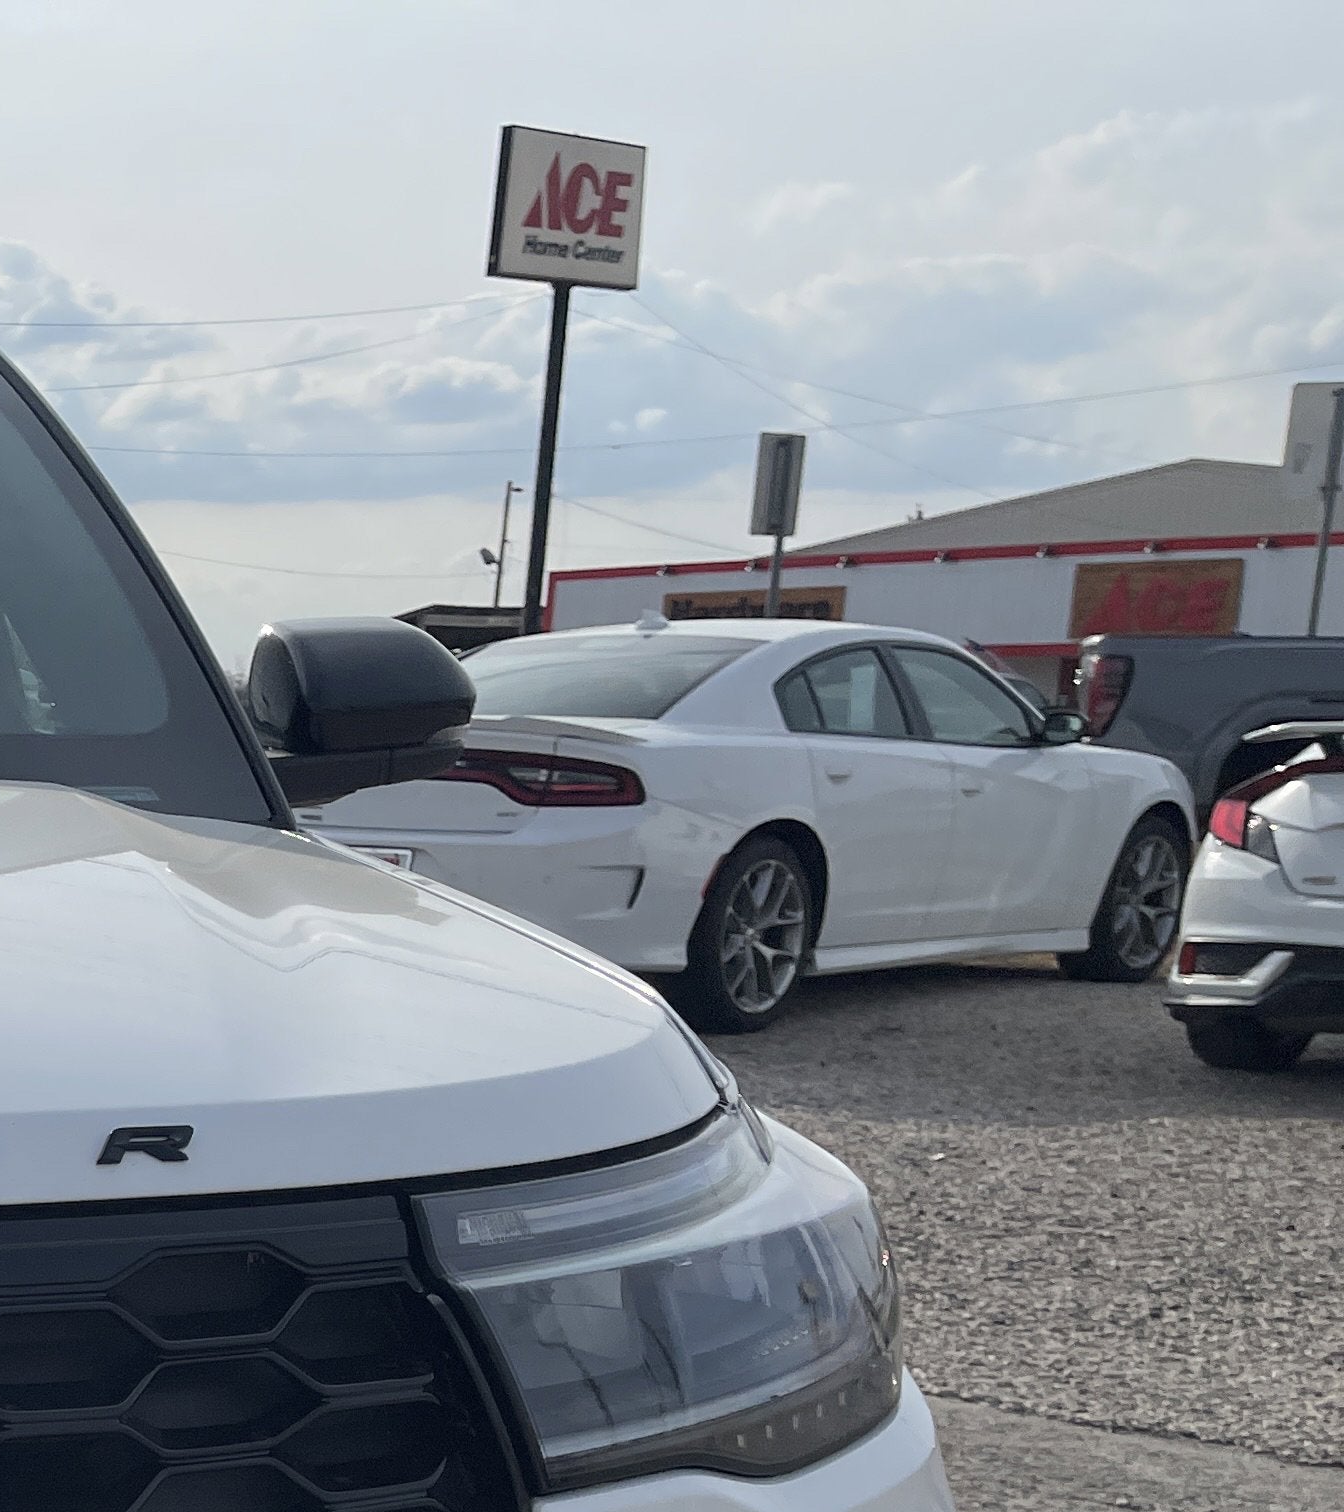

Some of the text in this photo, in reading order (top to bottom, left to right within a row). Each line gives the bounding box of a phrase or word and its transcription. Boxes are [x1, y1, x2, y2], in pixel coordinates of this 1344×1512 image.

[521, 151, 635, 239] ACE
[522, 235, 625, 264] Home Center
[1079, 572, 1231, 636] ACE
